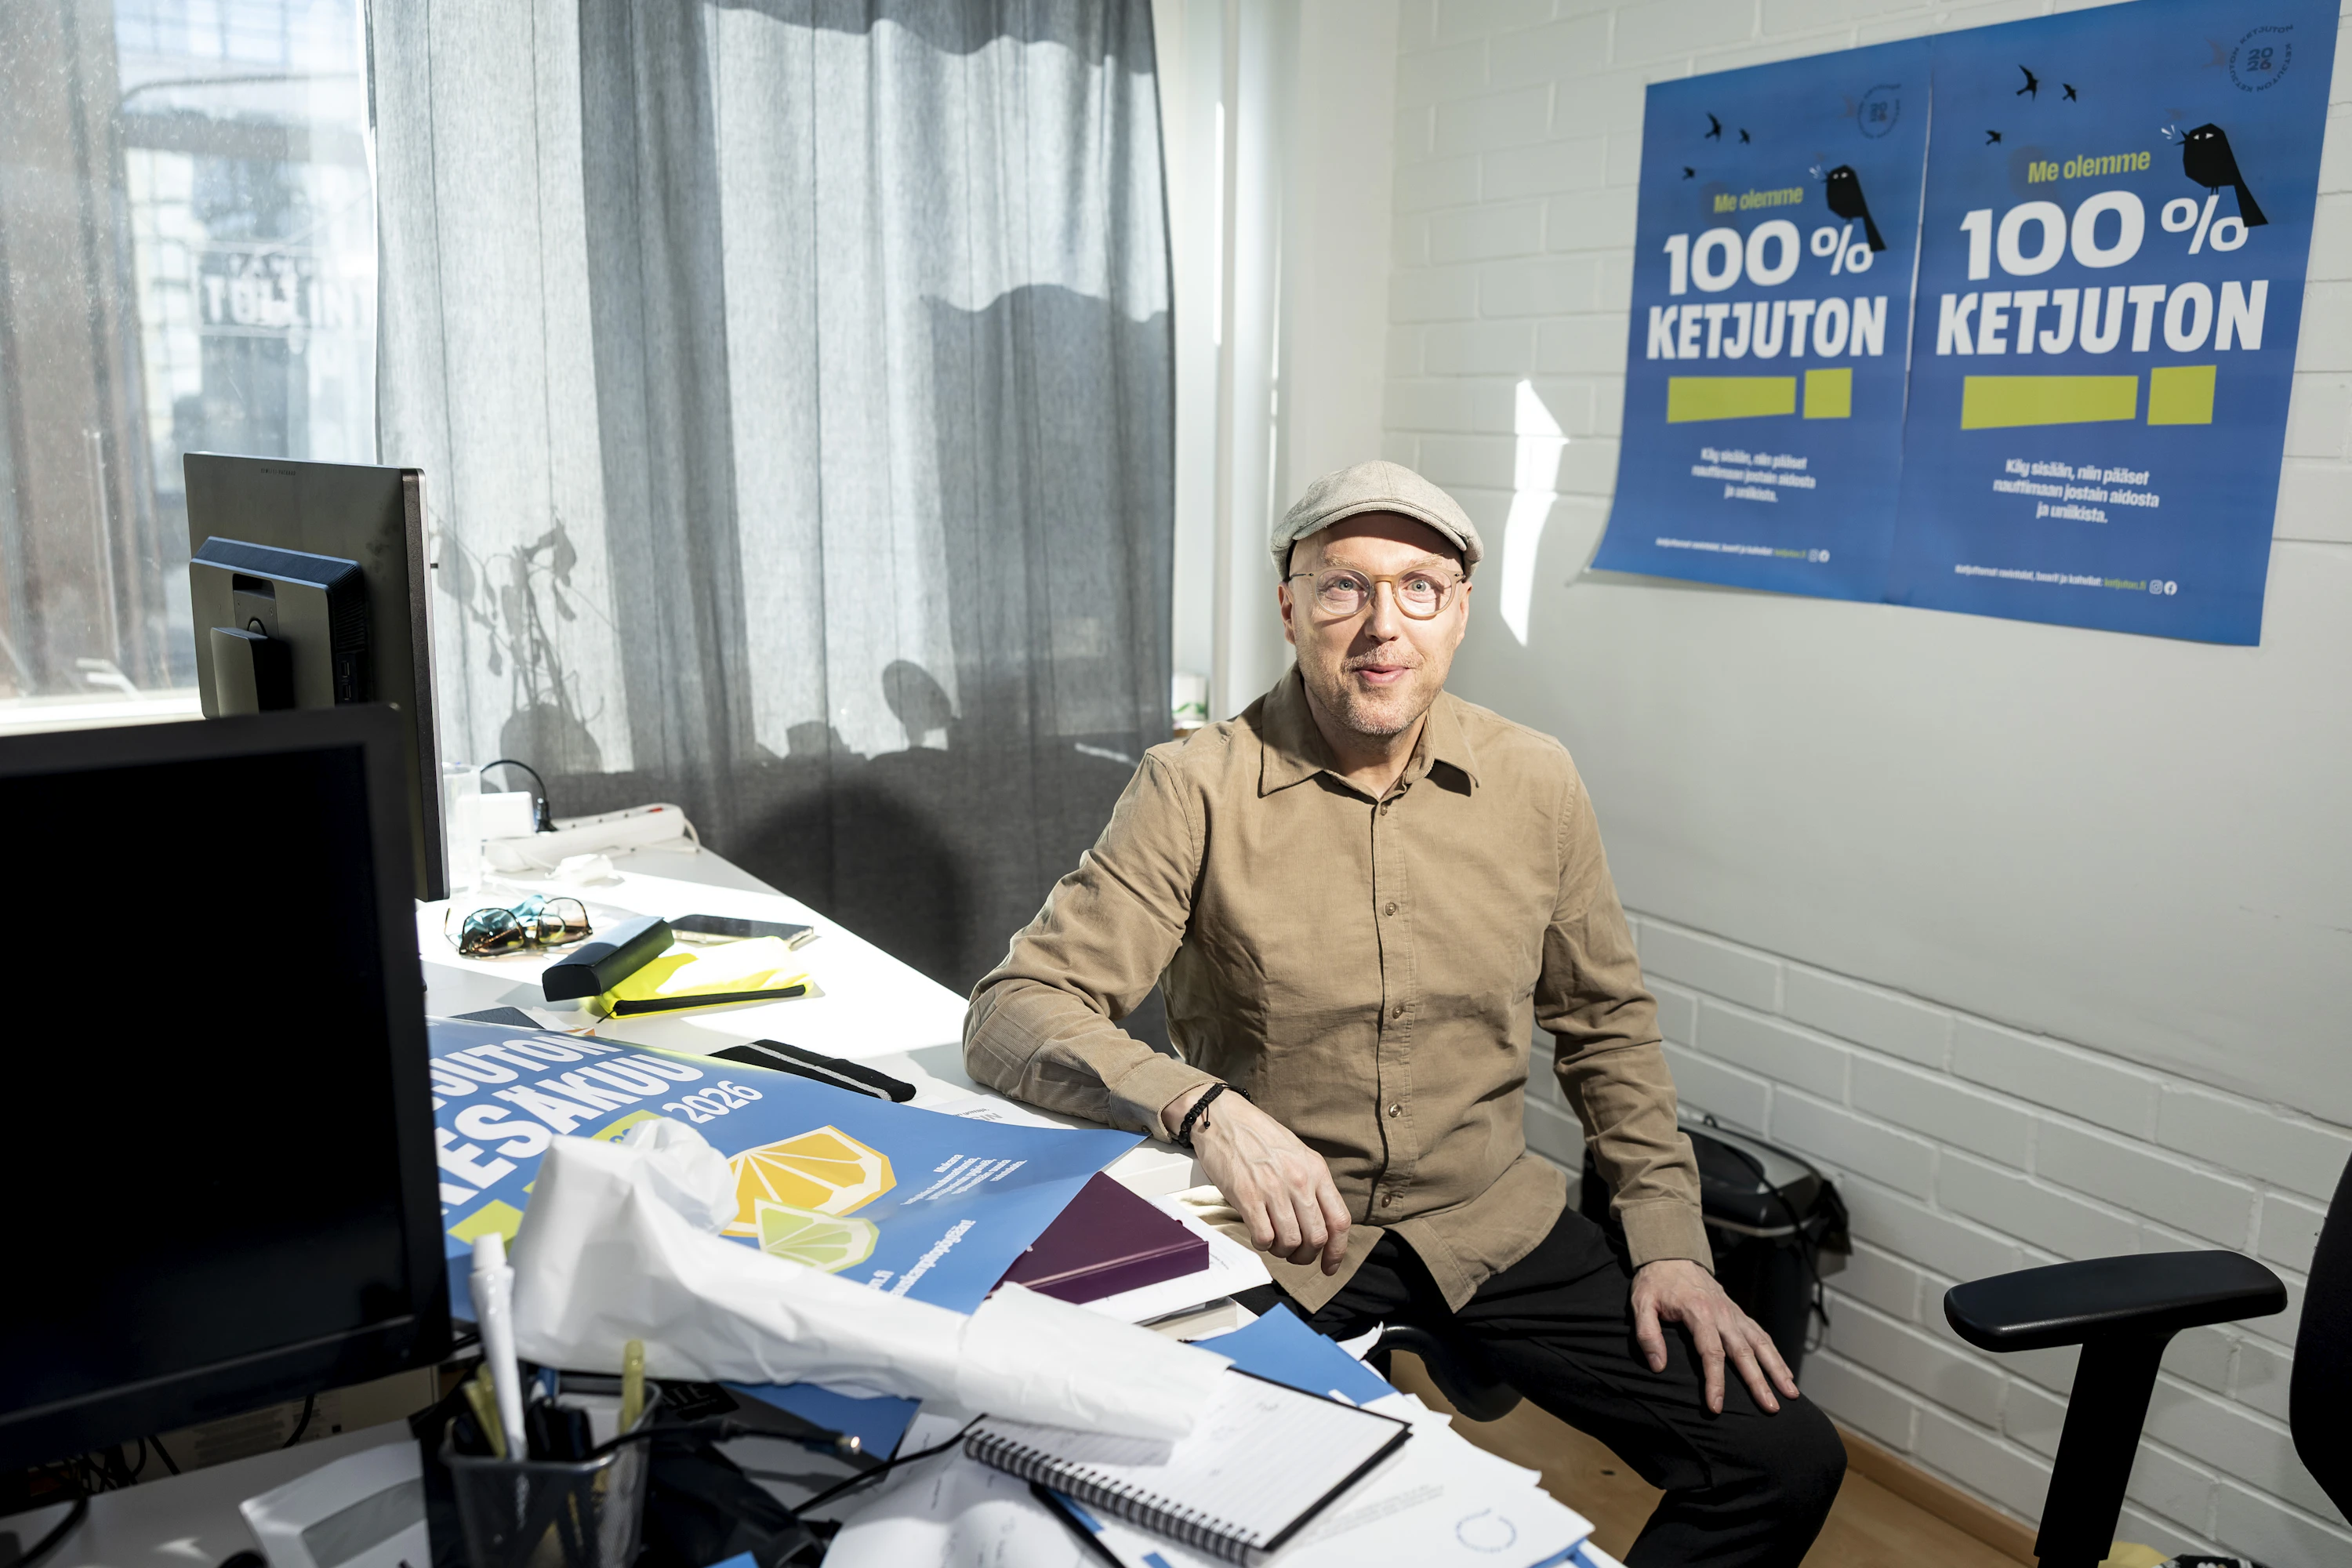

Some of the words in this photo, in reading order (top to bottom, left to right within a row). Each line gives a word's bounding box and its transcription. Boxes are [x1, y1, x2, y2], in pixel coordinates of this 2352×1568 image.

[2248, 47, 2274, 60] 20
[2028, 162, 2059, 184] Me
[2063, 151, 2151, 179] olemme
[1714, 194, 1737, 213] Me
[1740, 187, 1803, 209] olemme
[1960, 191, 2145, 281] 100
[2161, 194, 2249, 255] %
[1663, 220, 1801, 296] 100
[1810, 224, 1874, 275] %
[1647, 296, 1888, 360] KETJUTON
[1936, 280, 2269, 356] KETJUTON
[1700, 447, 1719, 464] Käy
[2005, 459, 2030, 477] Käy
[2031, 461, 2075, 481] sisään,
[2077, 464, 2102, 481] niin
[2103, 466, 2150, 485] pääset
[1993, 479, 2063, 499] nauttimaan
[2063, 484, 2108, 502] jostain
[2109, 488, 2160, 508] aidosta
[2036, 501, 2049, 519] ja
[2050, 504, 2109, 523] uniikista.
[430, 1036, 624, 1111] JUTON
[662, 1080, 763, 1123] 2026
